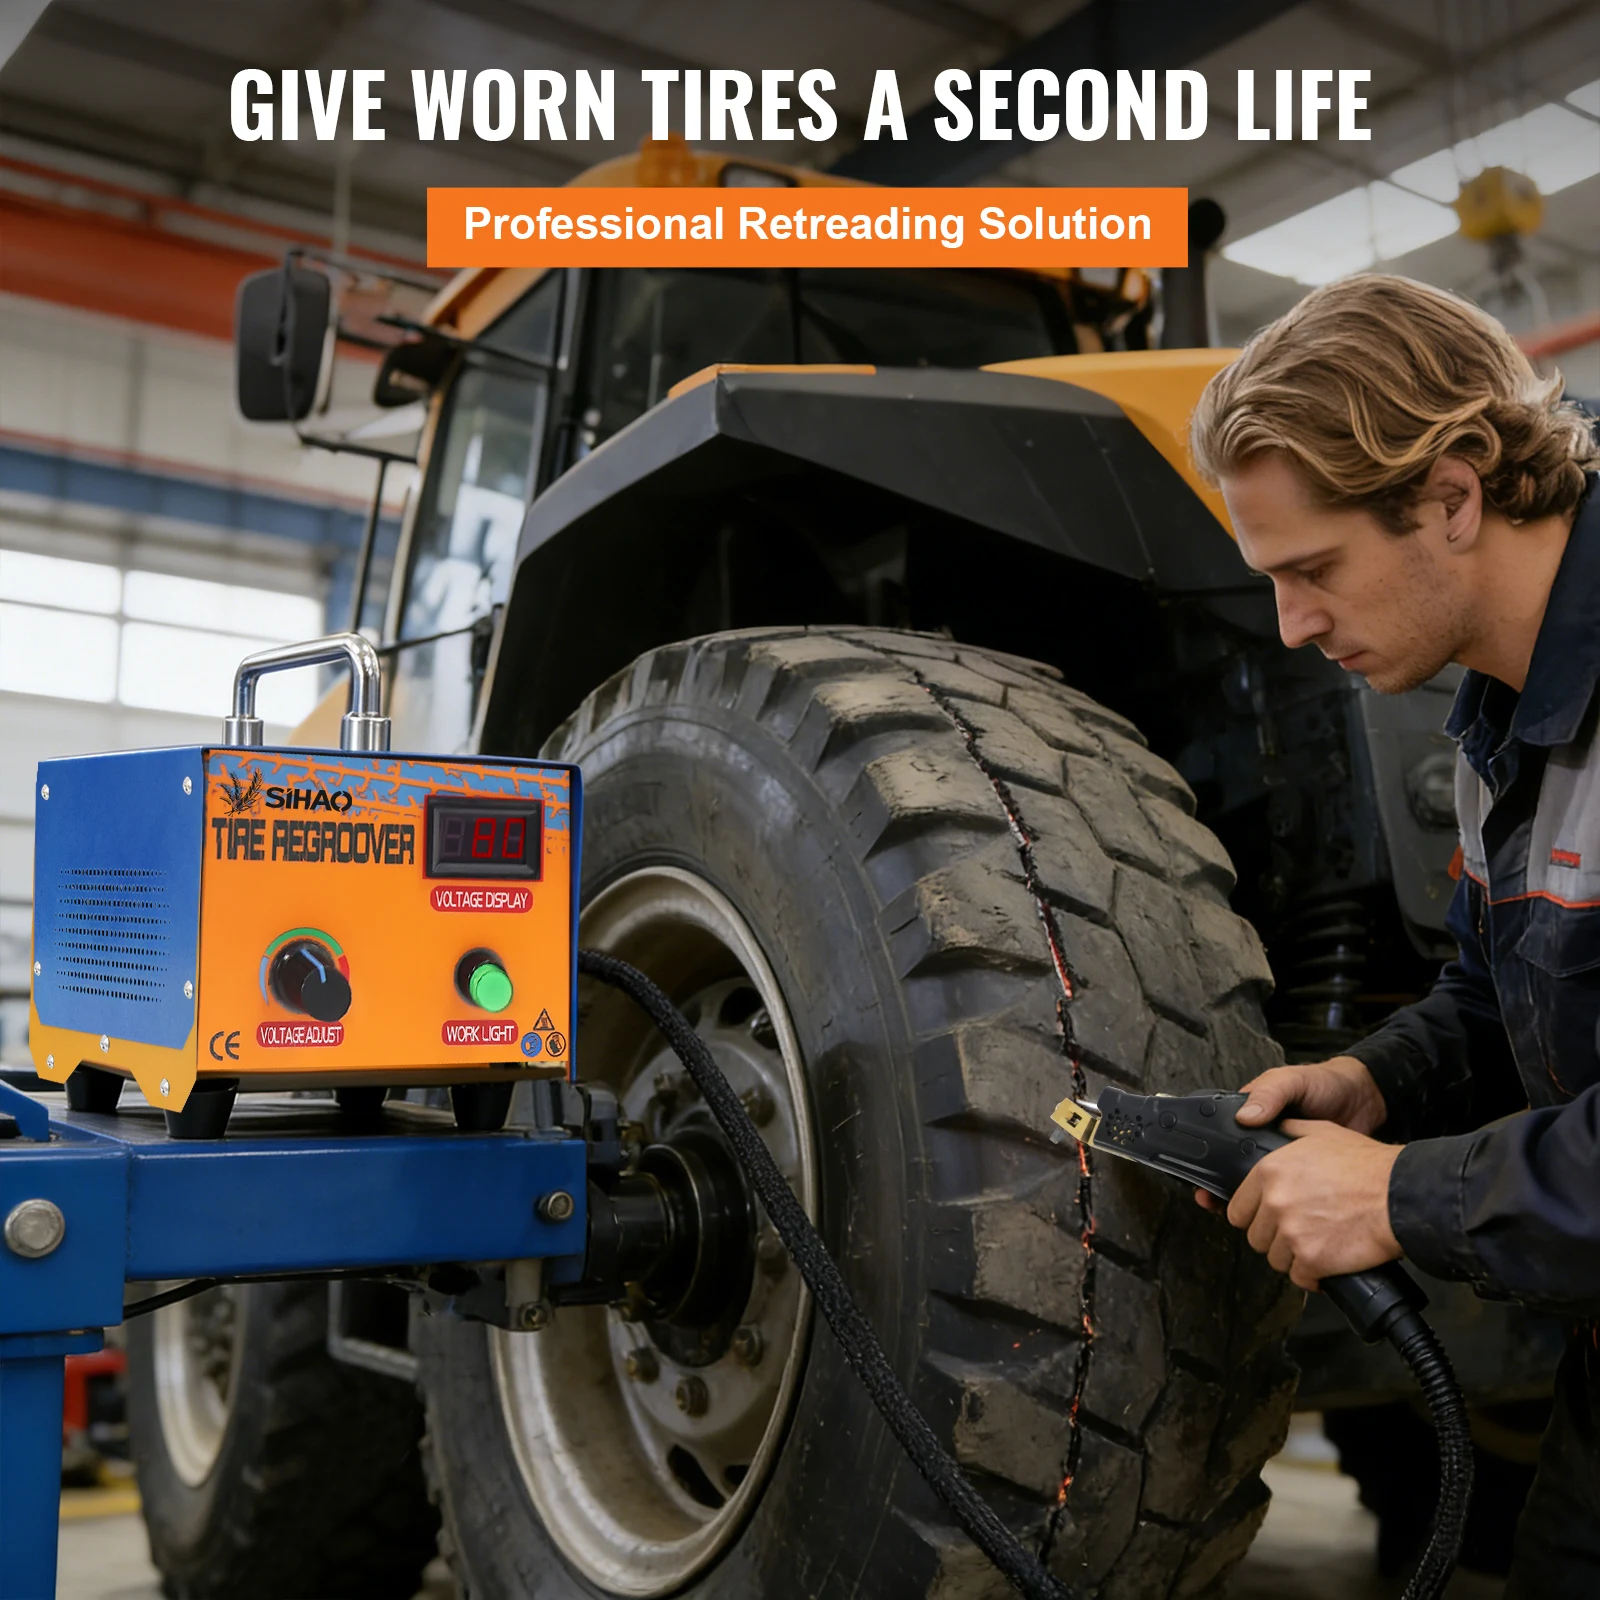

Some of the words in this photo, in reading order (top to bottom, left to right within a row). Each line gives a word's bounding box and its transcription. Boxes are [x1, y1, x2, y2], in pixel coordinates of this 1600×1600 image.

[212, 817, 265, 861] TIRE
[272, 819, 415, 865] REGROOVER
[472, 817, 525, 859] 80
[436, 890, 484, 909] VOLTAGE
[485, 891, 528, 909] DISPLAY
[260, 1026, 304, 1044] VOLTAGE
[305, 1026, 342, 1044] ADJUST
[446, 1025, 479, 1042] WORK
[481, 1025, 515, 1043] LIGHT
